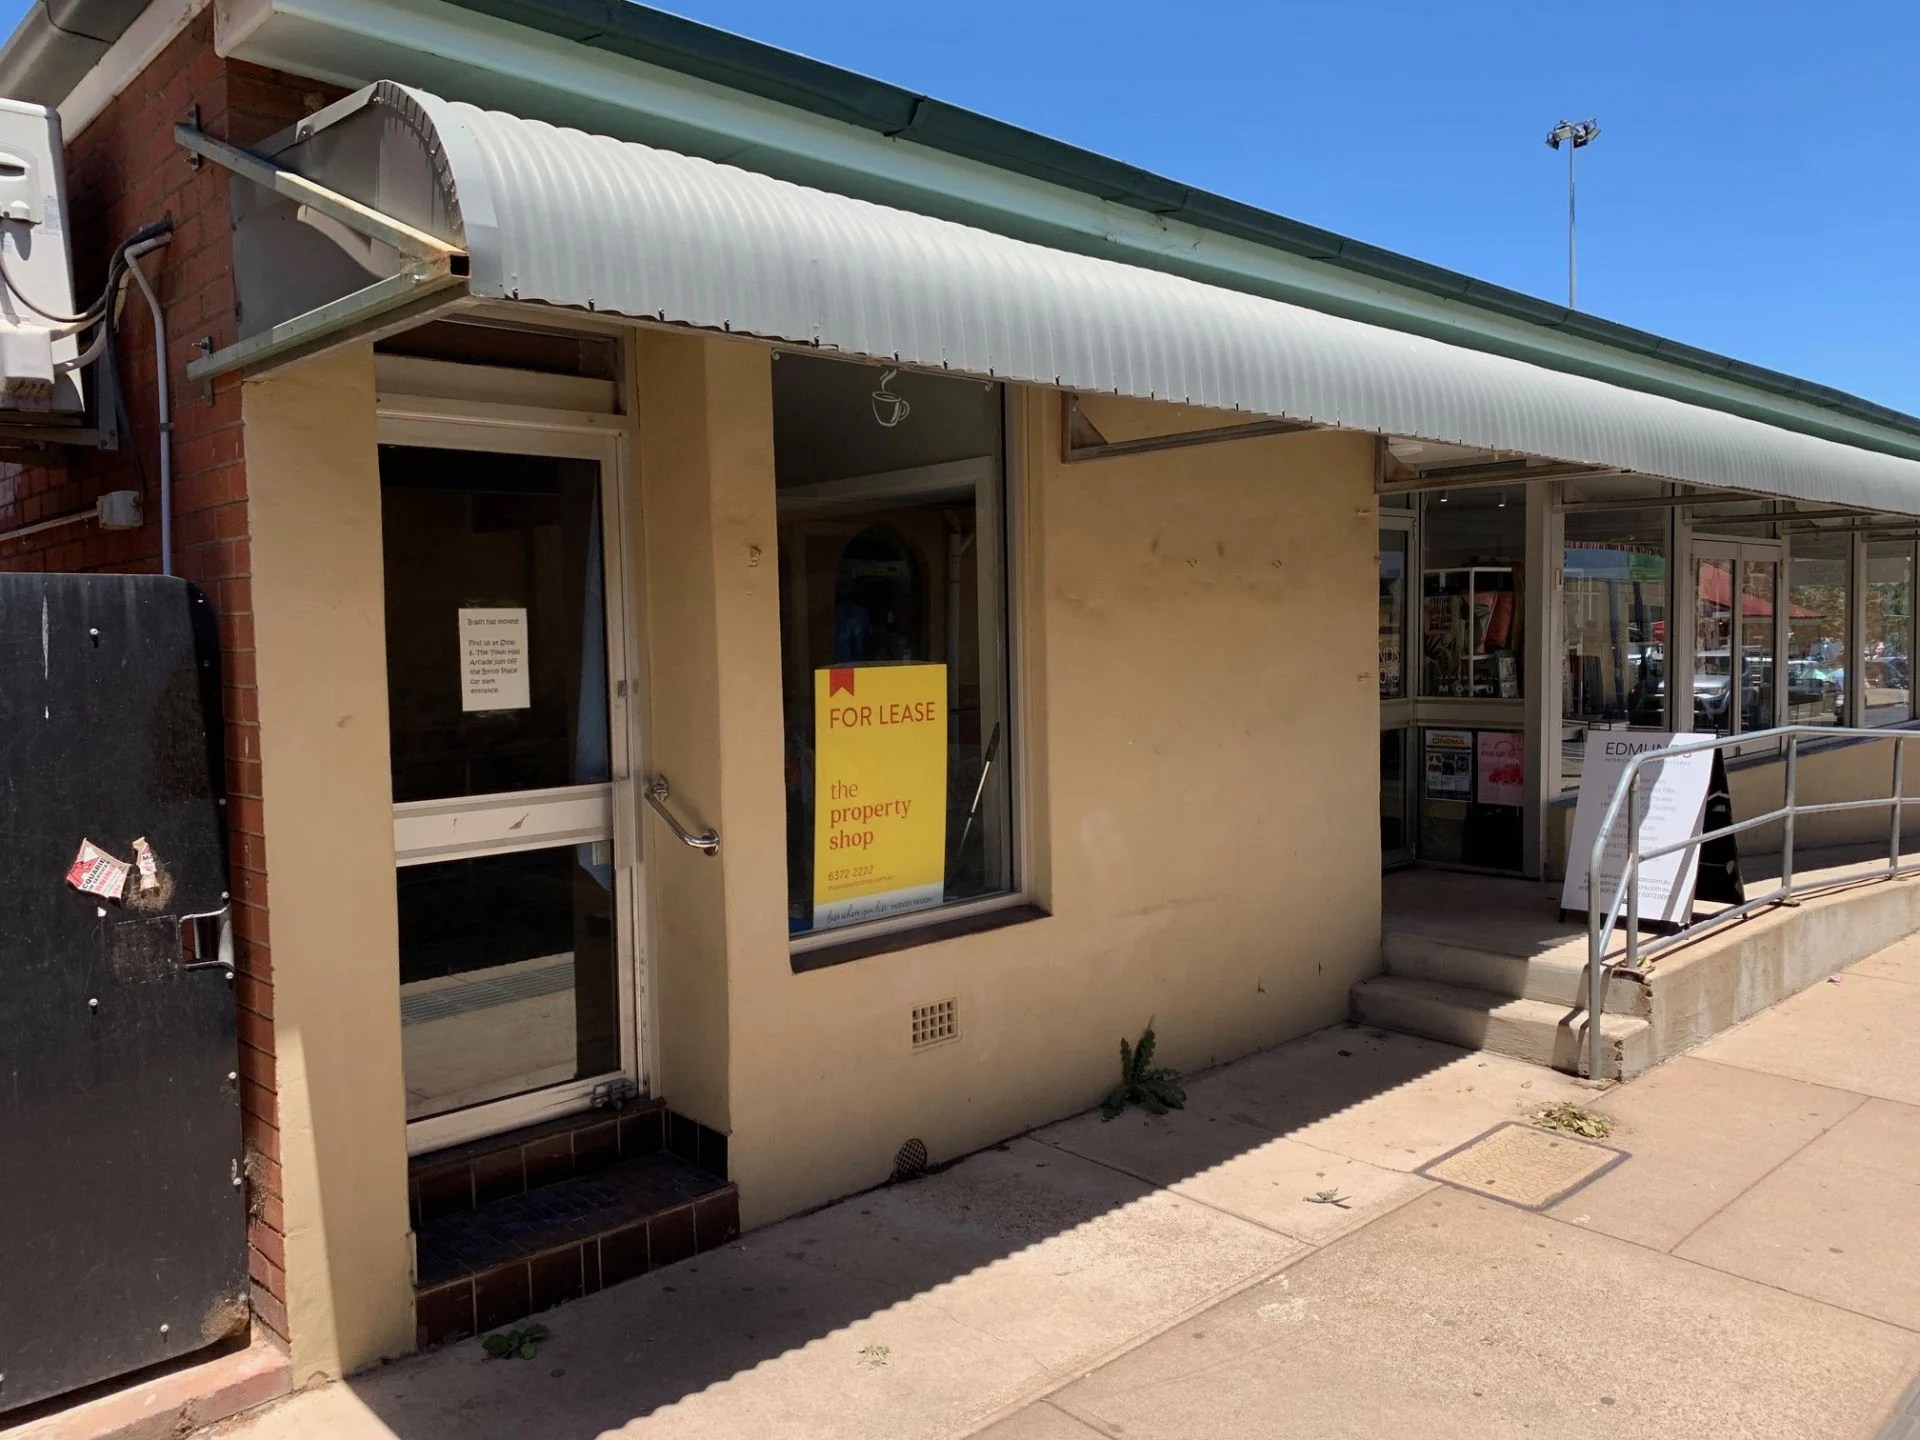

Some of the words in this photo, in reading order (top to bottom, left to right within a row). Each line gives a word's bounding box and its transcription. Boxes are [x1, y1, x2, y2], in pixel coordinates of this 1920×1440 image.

[829, 706, 873, 729] FOR
[879, 702, 936, 725] LEASE
[830, 780, 859, 800] the
[830, 799, 912, 829] property
[829, 829, 874, 851] shop
[828, 869, 850, 881] 6372
[852, 865, 875, 877] 2222
